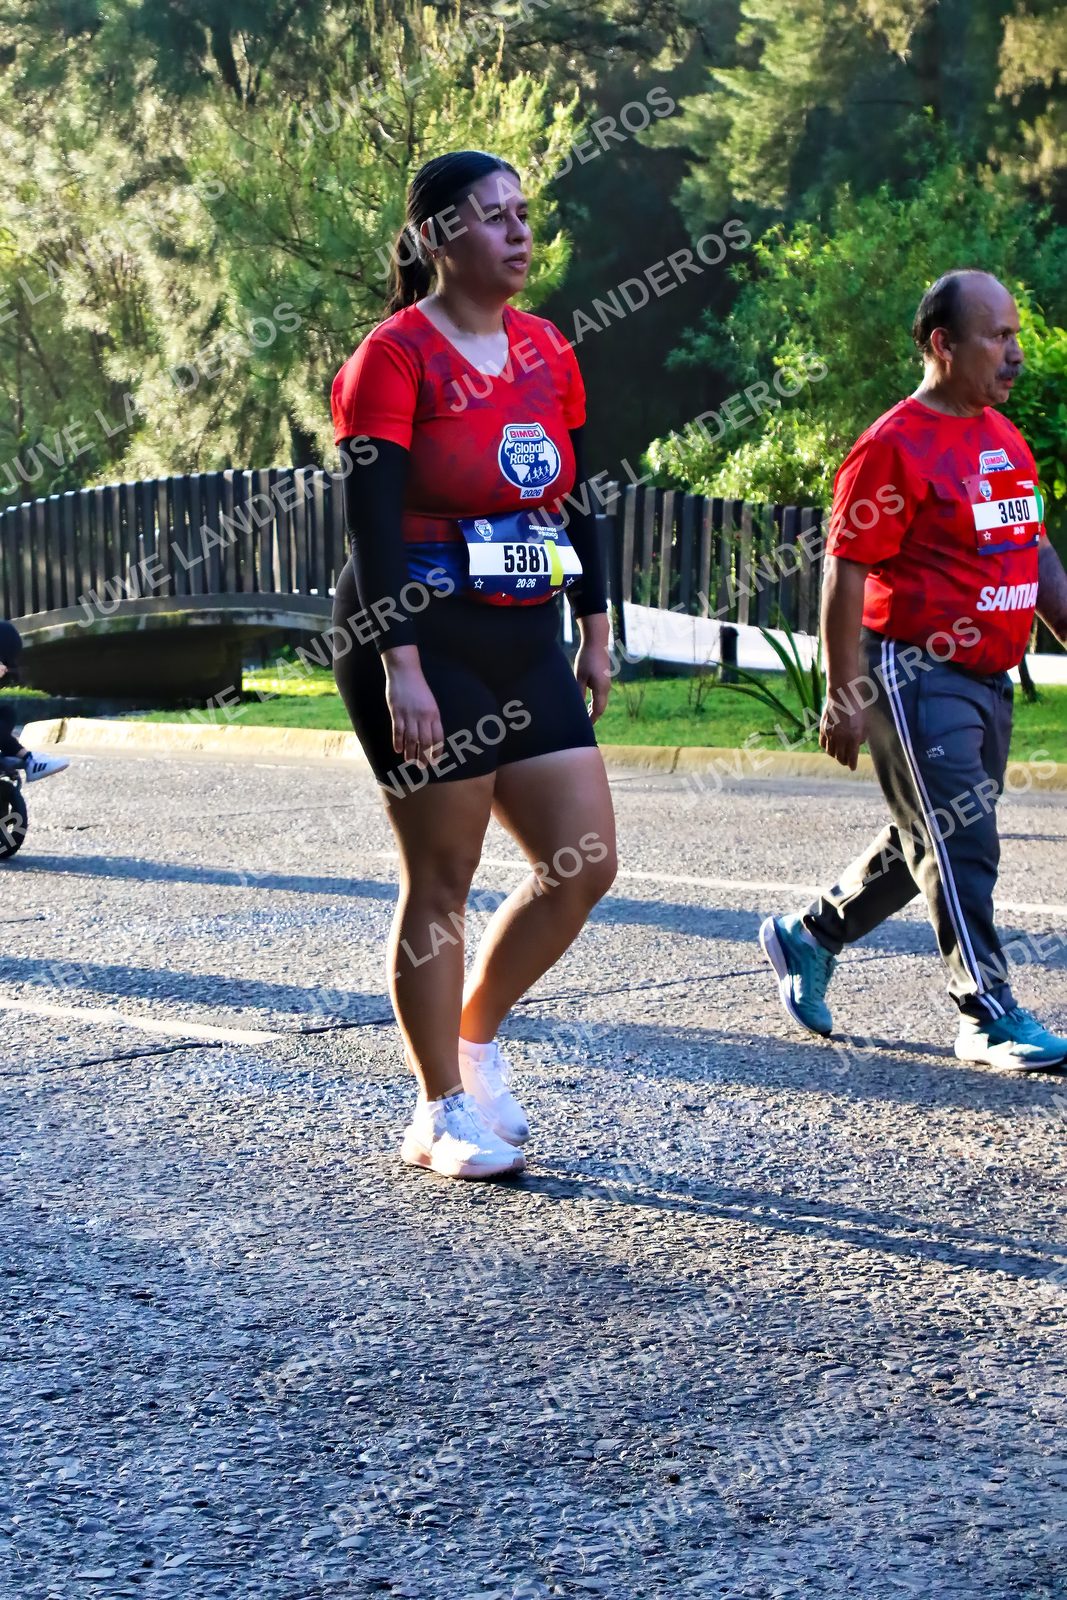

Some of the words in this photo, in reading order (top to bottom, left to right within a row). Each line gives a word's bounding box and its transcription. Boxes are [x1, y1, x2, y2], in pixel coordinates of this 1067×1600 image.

[510, 430, 541, 438] BIMBO
[514, 441, 544, 454] Global
[510, 453, 535, 464] Race
[522, 489, 542, 498] 2026
[998, 499, 1030, 524] 3490
[503, 545, 548, 573] 5381
